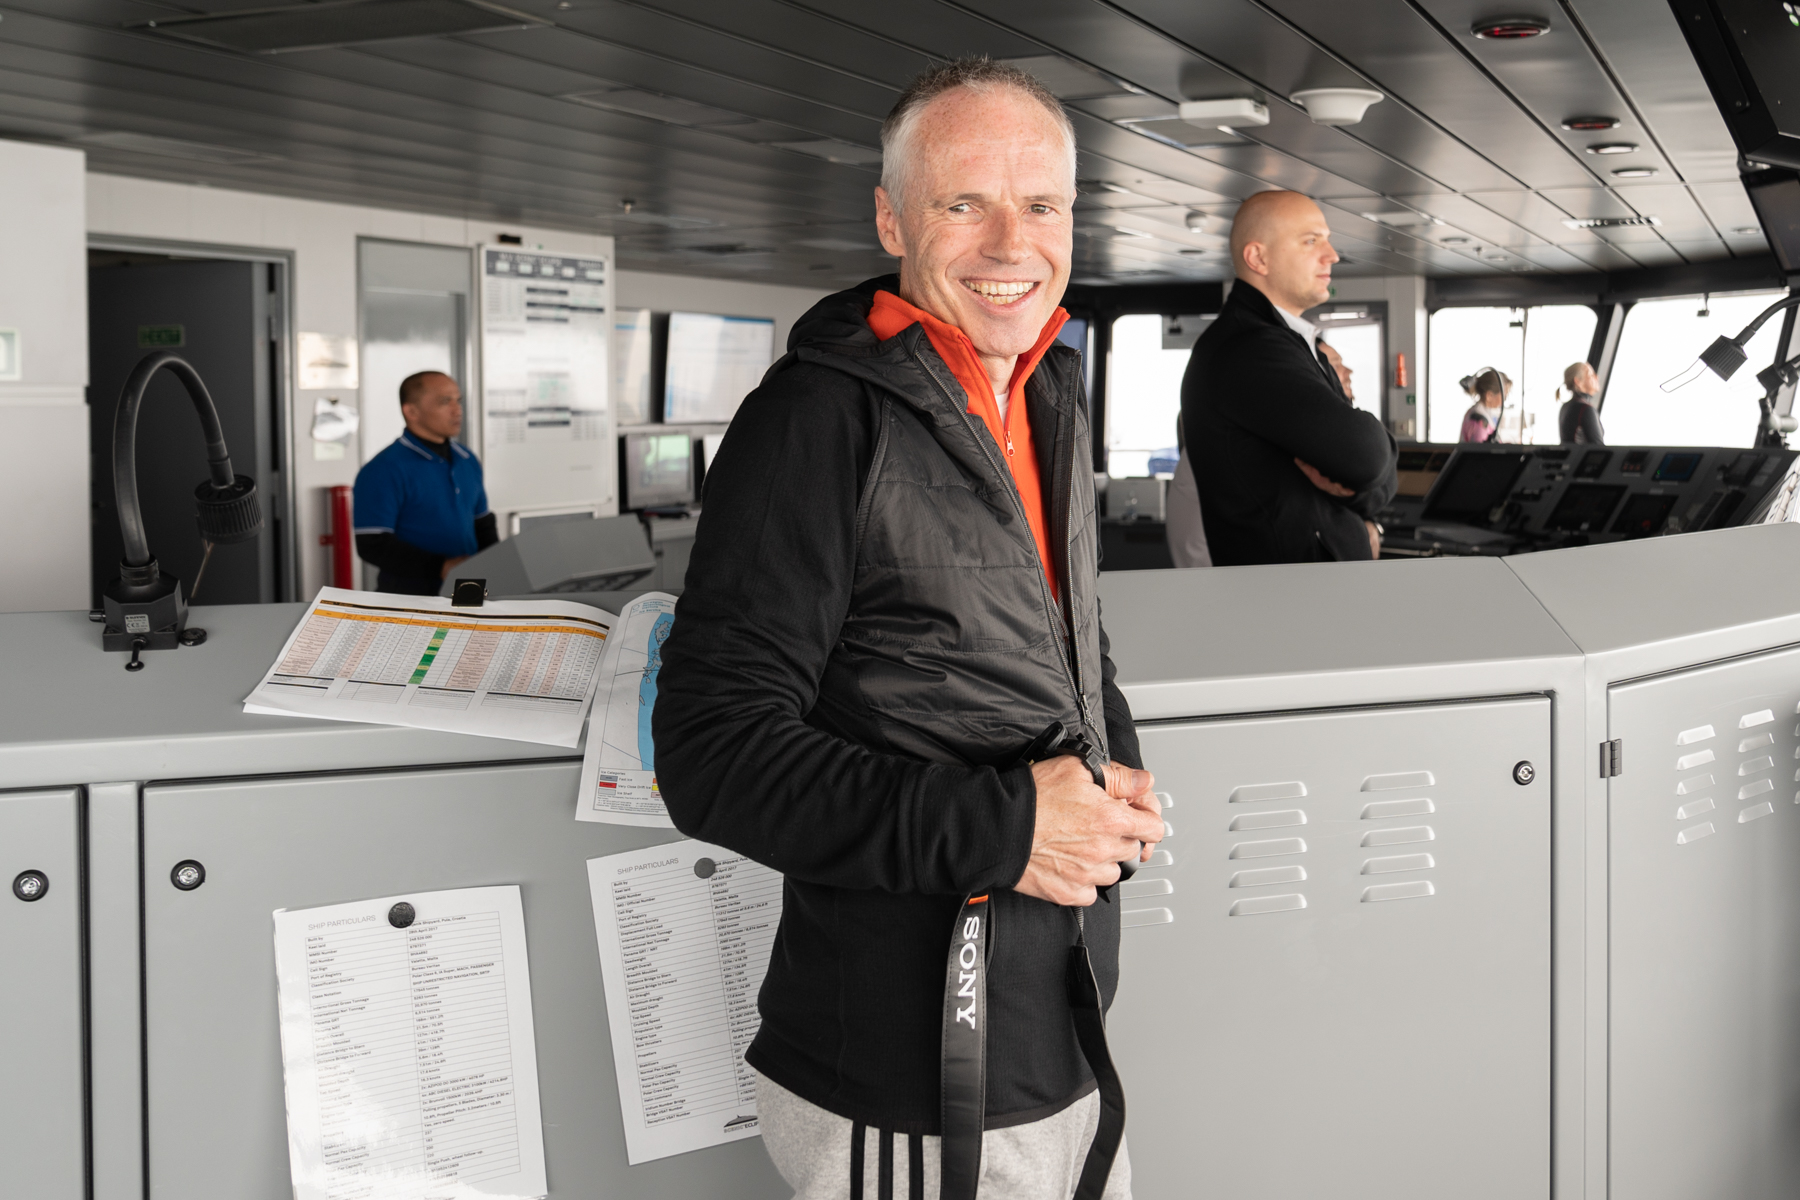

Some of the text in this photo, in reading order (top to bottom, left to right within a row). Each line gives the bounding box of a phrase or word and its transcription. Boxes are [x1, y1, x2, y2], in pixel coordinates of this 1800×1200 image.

[617, 858, 679, 875] SHIP PARTICULARS
[308, 915, 376, 931] SHIP PARTICULARS
[956, 916, 980, 1030] SONY
